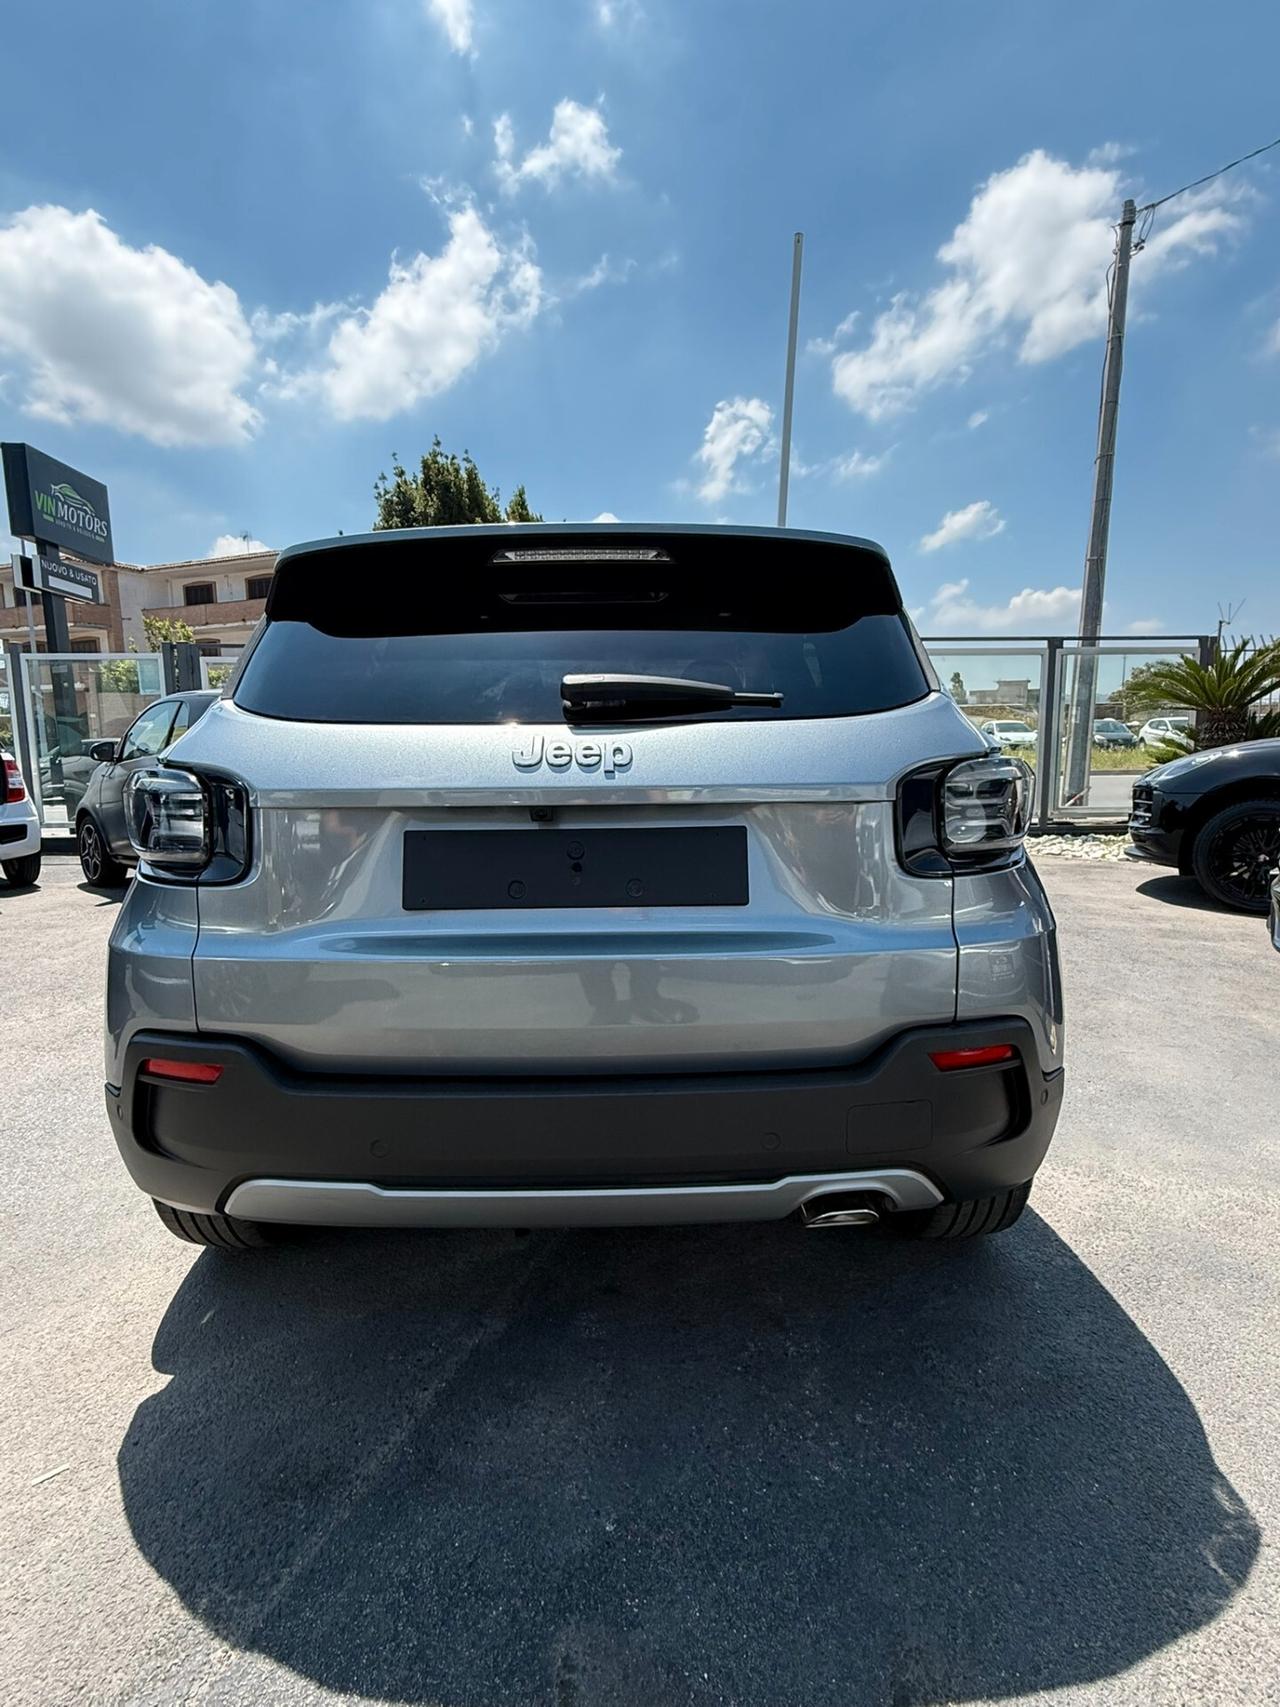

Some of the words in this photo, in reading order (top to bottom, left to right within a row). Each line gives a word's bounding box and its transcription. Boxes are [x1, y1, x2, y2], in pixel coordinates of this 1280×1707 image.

[35, 490, 56, 516] VIN
[58, 501, 107, 536] MOTORS
[41, 559, 68, 576] NUOVO
[69, 568, 74, 578] &
[75, 572, 97, 586] USATO
[512, 735, 633, 775] Jeep
